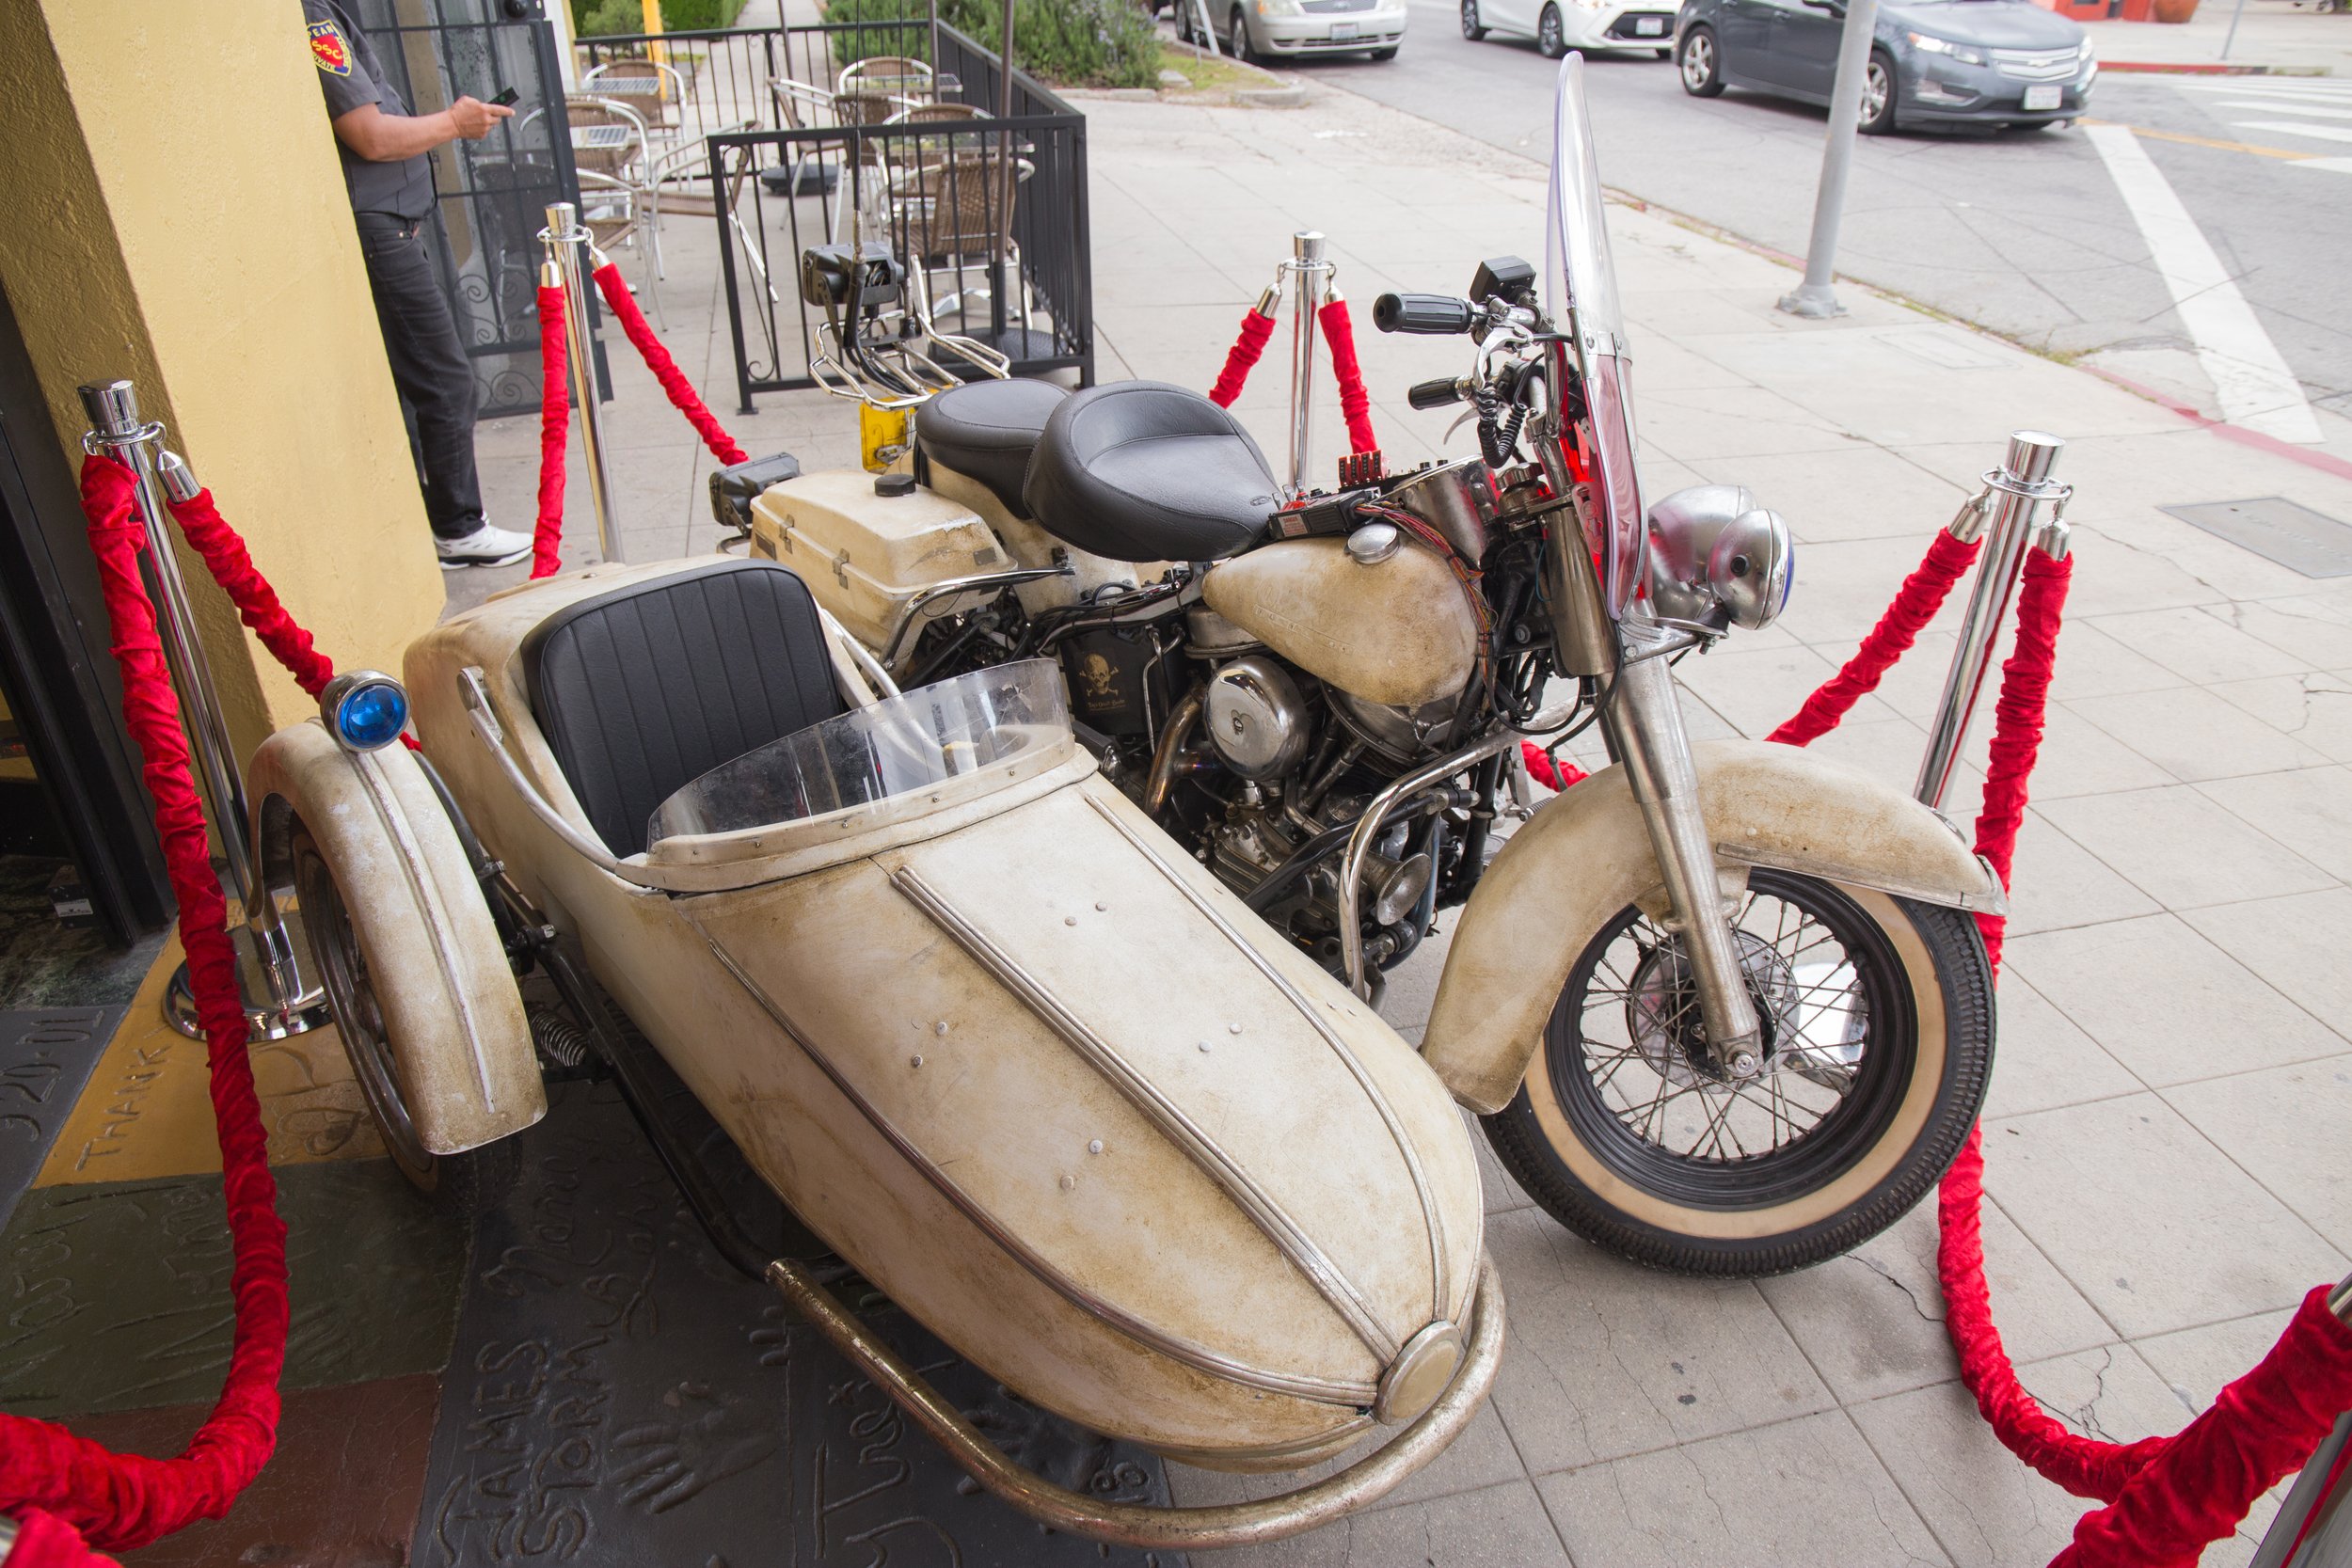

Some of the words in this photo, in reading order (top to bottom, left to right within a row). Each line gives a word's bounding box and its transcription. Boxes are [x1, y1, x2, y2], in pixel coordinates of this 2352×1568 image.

[311, 40, 342, 60] SSC
[435, 1339, 548, 1566] JAMES
[513, 1334, 612, 1560] STORM
